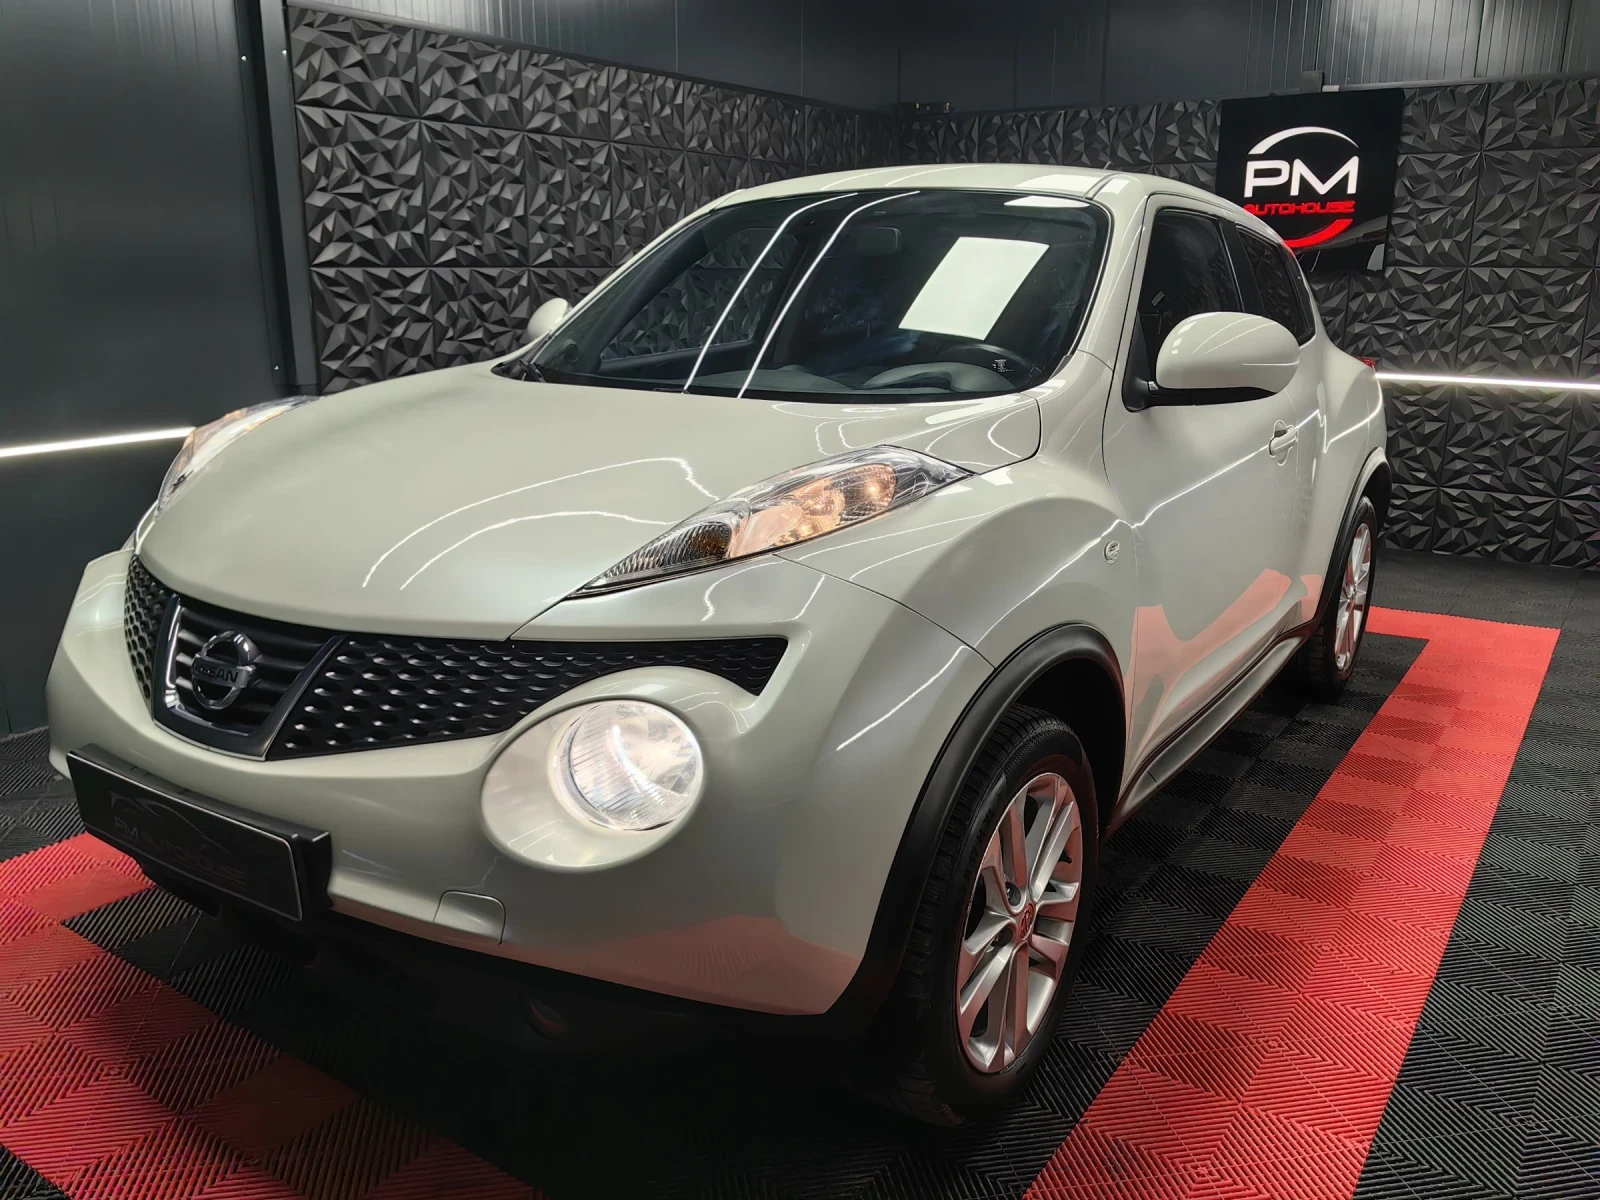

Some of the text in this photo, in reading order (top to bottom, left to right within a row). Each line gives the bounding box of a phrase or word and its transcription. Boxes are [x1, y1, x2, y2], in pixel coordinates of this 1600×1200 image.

[1244, 156, 1358, 198] PM
[1244, 200, 1355, 215] AUTOHOUSE
[114, 816, 139, 840] PM
